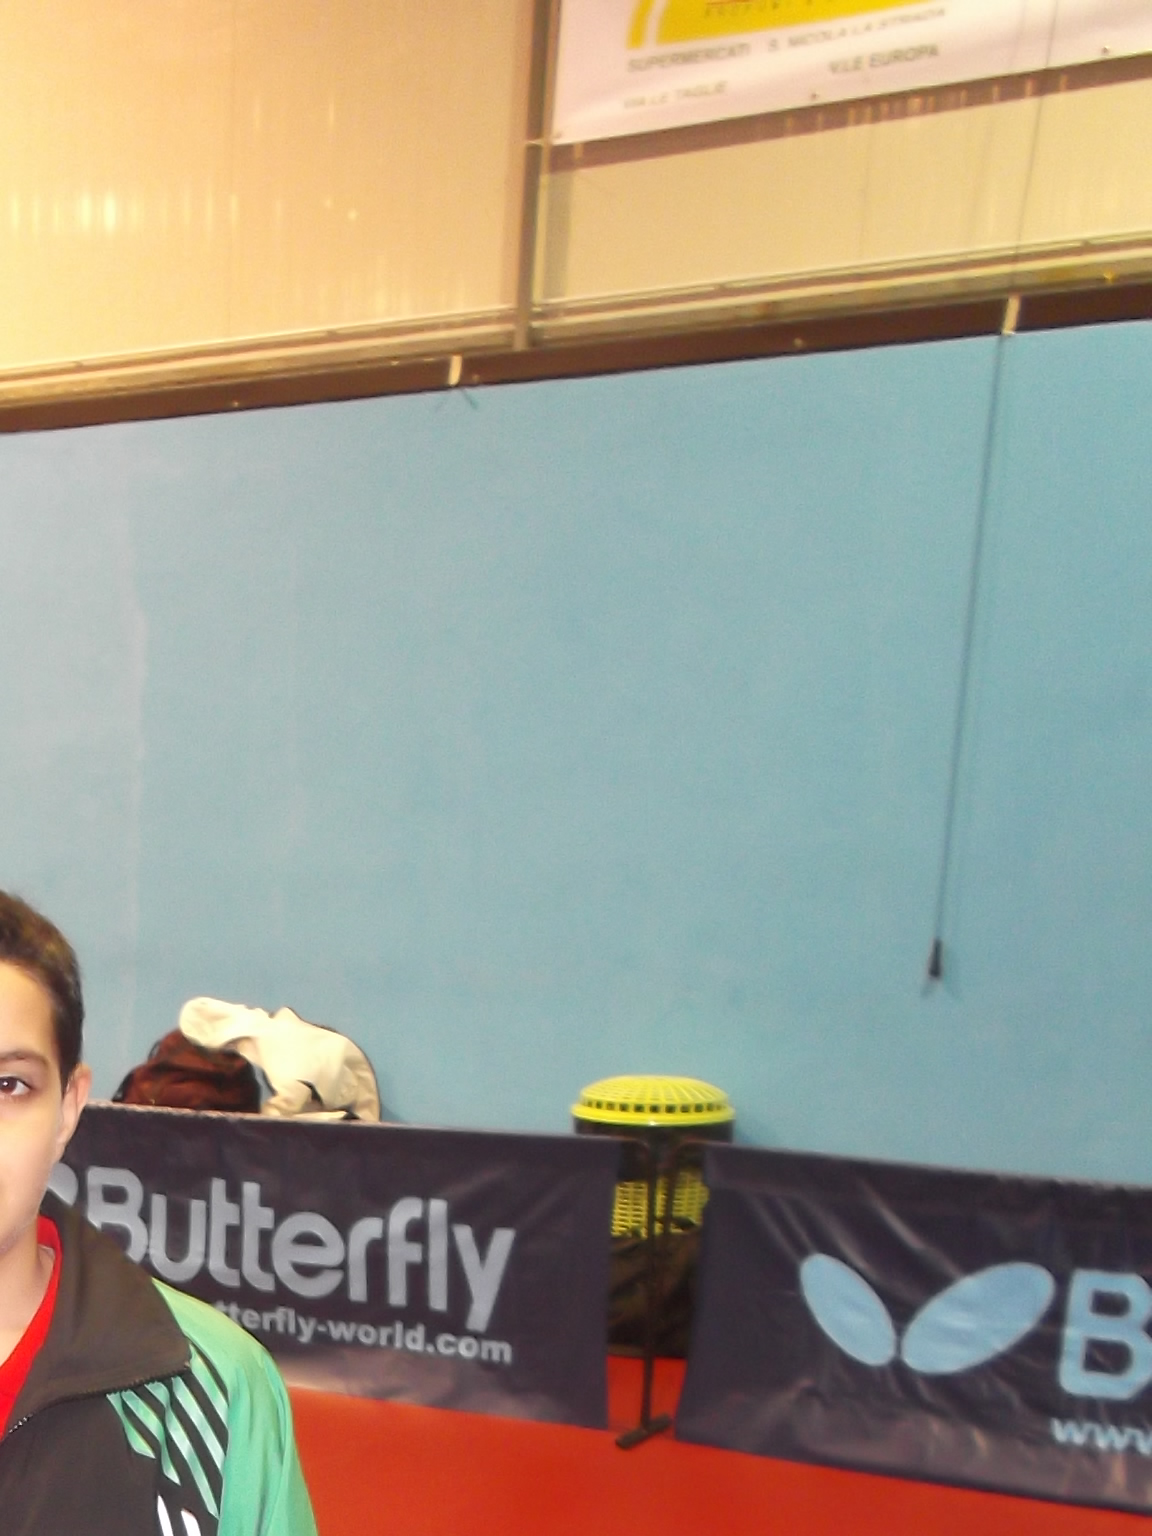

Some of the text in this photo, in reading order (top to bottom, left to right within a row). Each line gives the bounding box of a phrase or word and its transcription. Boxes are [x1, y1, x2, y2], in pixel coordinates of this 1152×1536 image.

[870, 44, 939, 67] EUROPA
[85, 1165, 516, 1332] Butterfly
[217, 1300, 513, 1364] terfly-world.com
